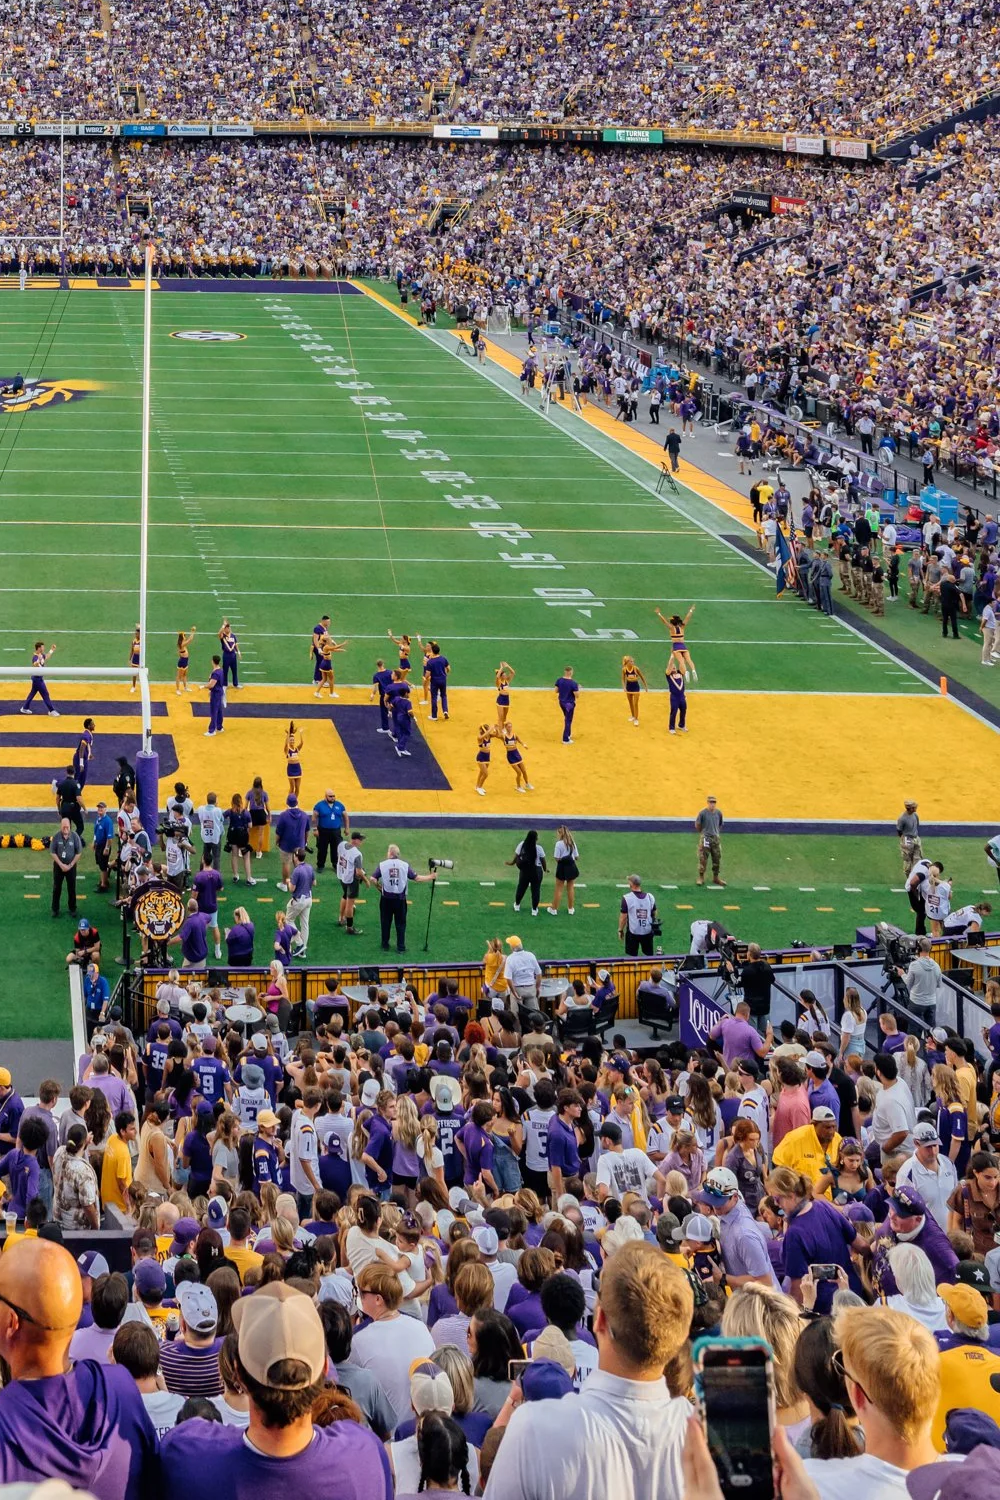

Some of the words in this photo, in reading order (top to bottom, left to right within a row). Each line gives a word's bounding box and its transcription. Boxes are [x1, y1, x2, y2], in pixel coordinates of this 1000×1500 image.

[18, 123, 31, 133] 25
[540, 130, 565, 140] 14:51
[733, 196, 748, 205] CAMPUS
[752, 198, 769, 208] FEDERAL
[420, 471, 475, 484] 30
[443, 495, 502, 510] 25
[469, 522, 533, 538] 20
[498, 553, 566, 569] 15
[532, 588, 606, 607] 10
[570, 628, 639, 640] 5
[930, 906, 939, 914] 21
[152, 1050, 168, 1070] 33
[203, 1075, 214, 1094] 9
[246, 1106, 258, 1122] 3
[441, 1128, 454, 1155] 2
[538, 1132, 549, 1158] 3
[259, 1161, 269, 1174] 20
[964, 1352, 985, 1361] TIGERS
